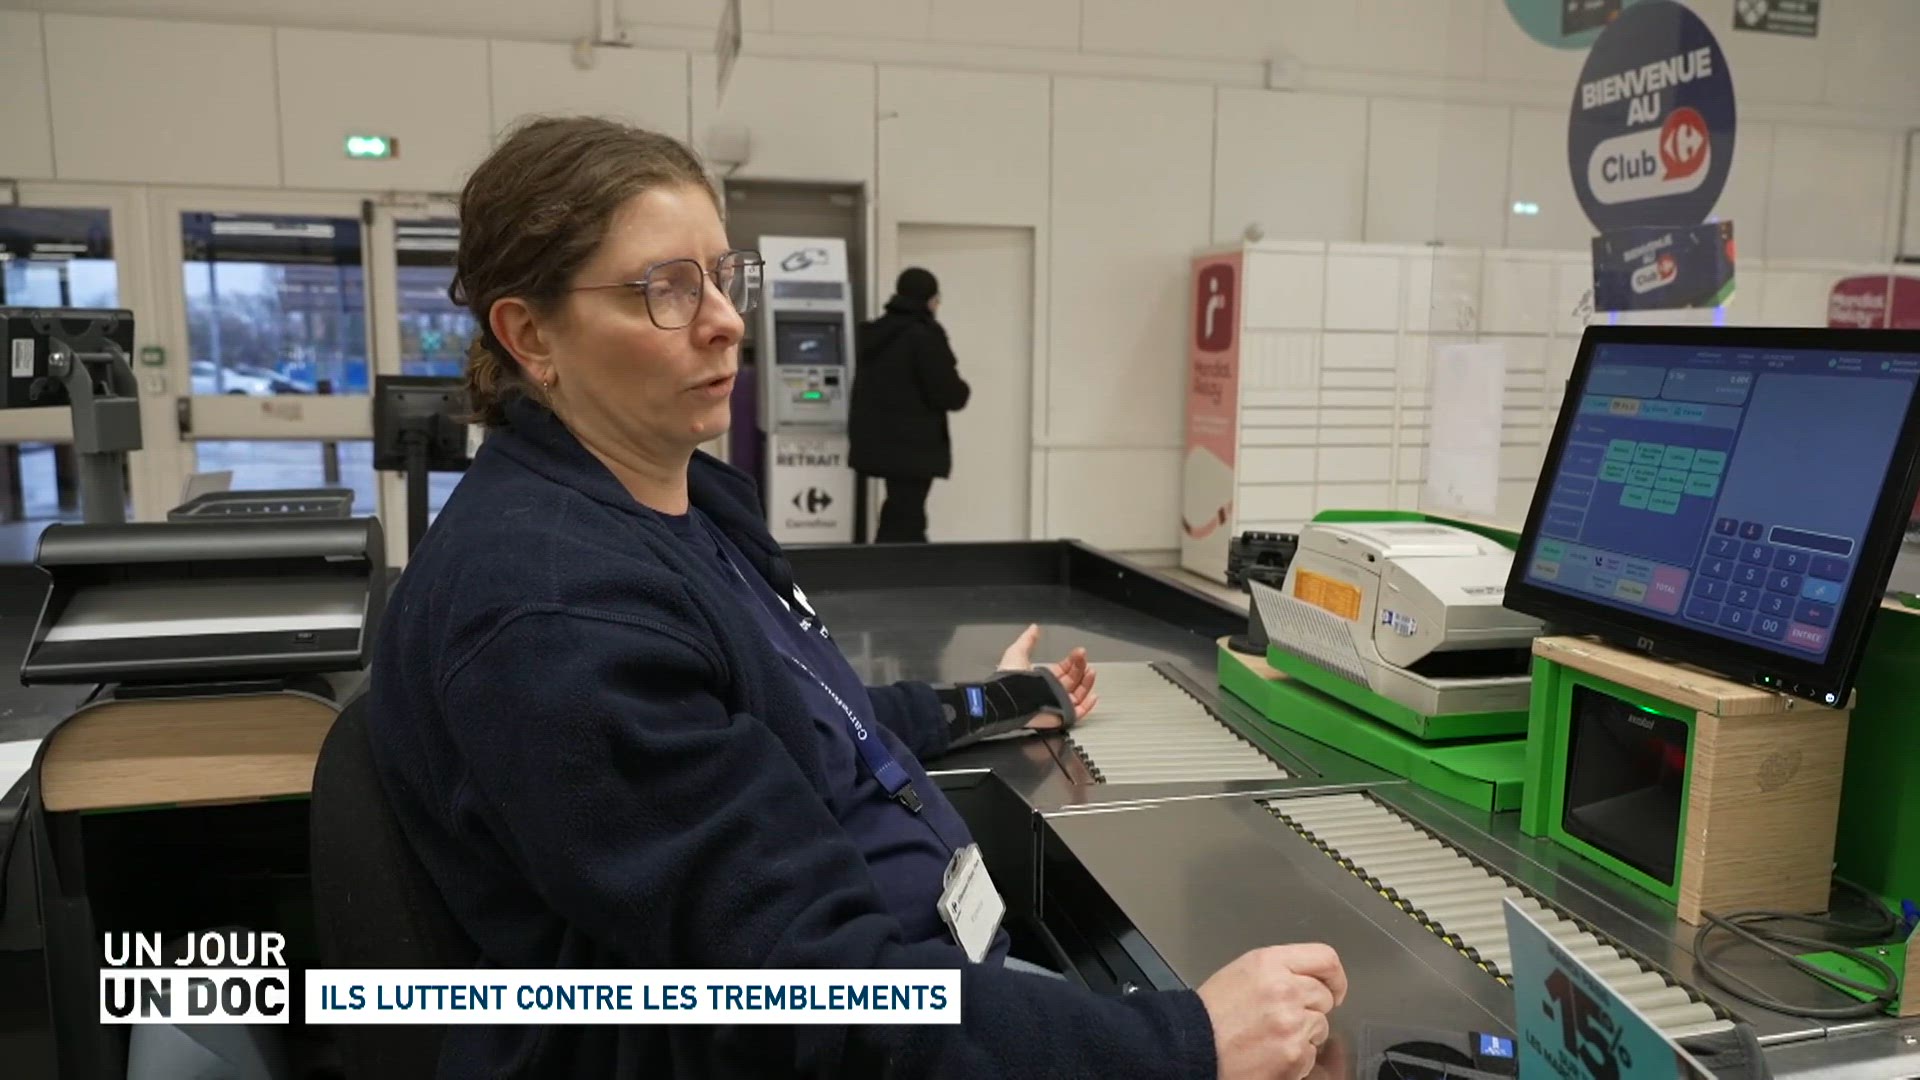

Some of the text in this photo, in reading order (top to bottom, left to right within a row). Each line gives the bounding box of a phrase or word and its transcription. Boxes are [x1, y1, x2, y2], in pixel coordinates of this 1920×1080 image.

[1582, 47, 1712, 110] BIENVENUE
[1626, 92, 1661, 127] AU
[1602, 149, 1656, 183] Club
[776, 453, 841, 467] RETRAIT
[1720, 540, 1729, 552] 7
[1752, 547, 1762, 559] 8
[1787, 553, 1797, 567] 9
[1712, 563, 1721, 574] 4
[1745, 568, 1755, 580] 5
[1779, 576, 1789, 588] 6
[1655, 582, 1676, 595] TOTAL
[1706, 583, 1714, 595] 1
[1739, 590, 1748, 602] 2
[1772, 598, 1782, 611] 3
[1731, 611, 1741, 623] 0
[1761, 618, 1779, 633] 00
